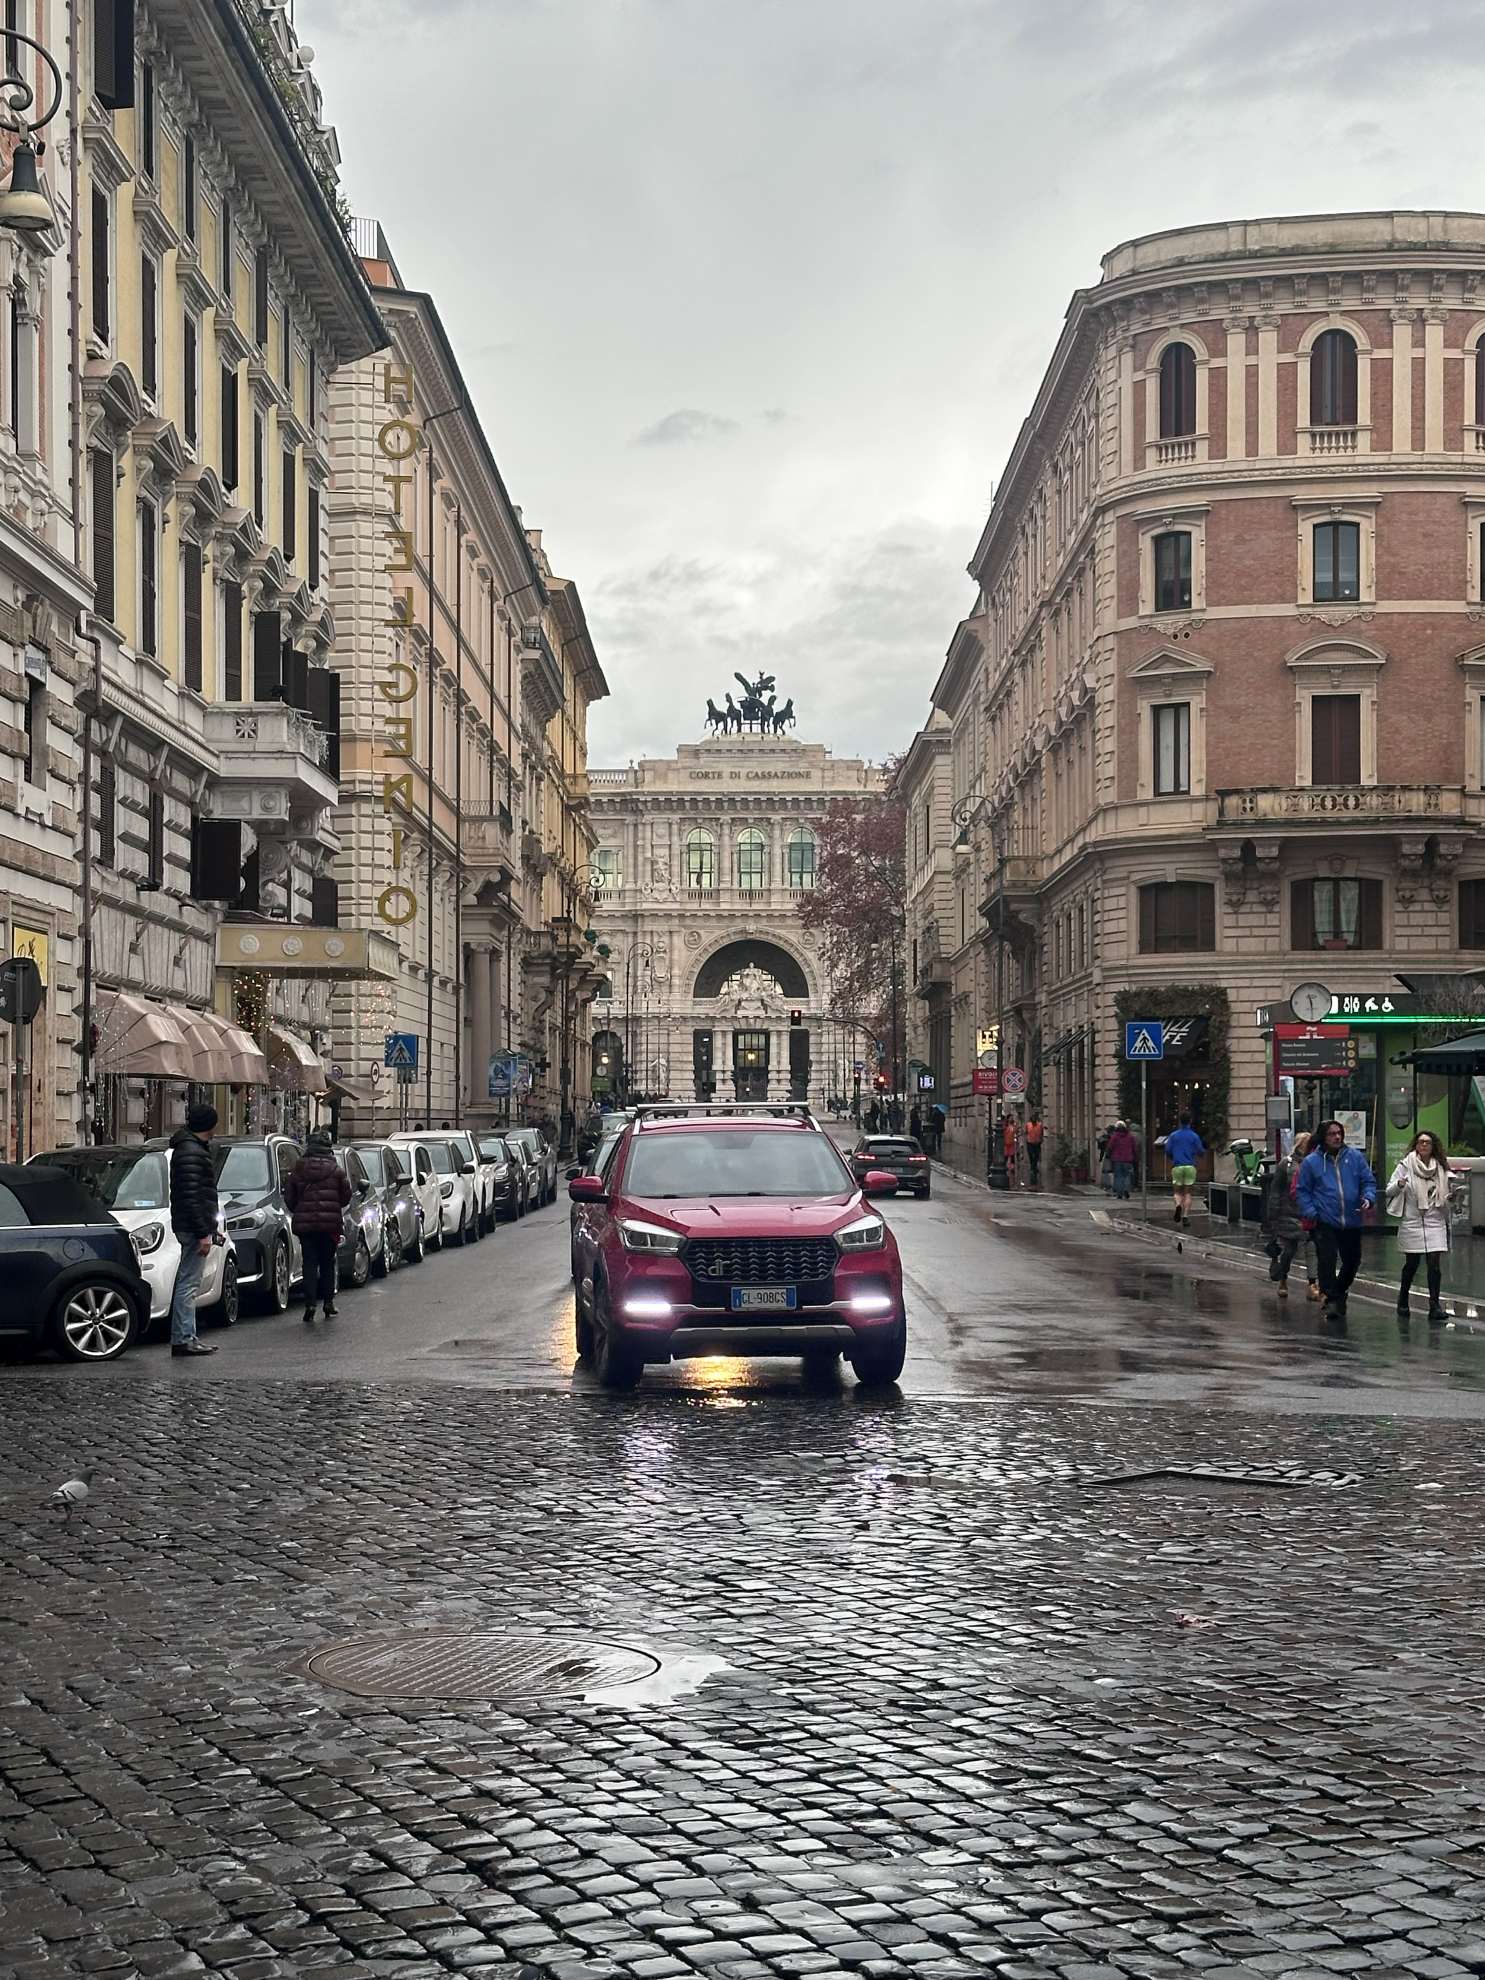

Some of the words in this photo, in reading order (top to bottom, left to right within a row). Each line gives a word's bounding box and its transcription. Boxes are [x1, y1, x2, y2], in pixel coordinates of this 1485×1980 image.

[689, 771, 723, 780] CORTE
[729, 771, 741, 780] DI
[746, 771, 812, 780] CASSAZIONE
